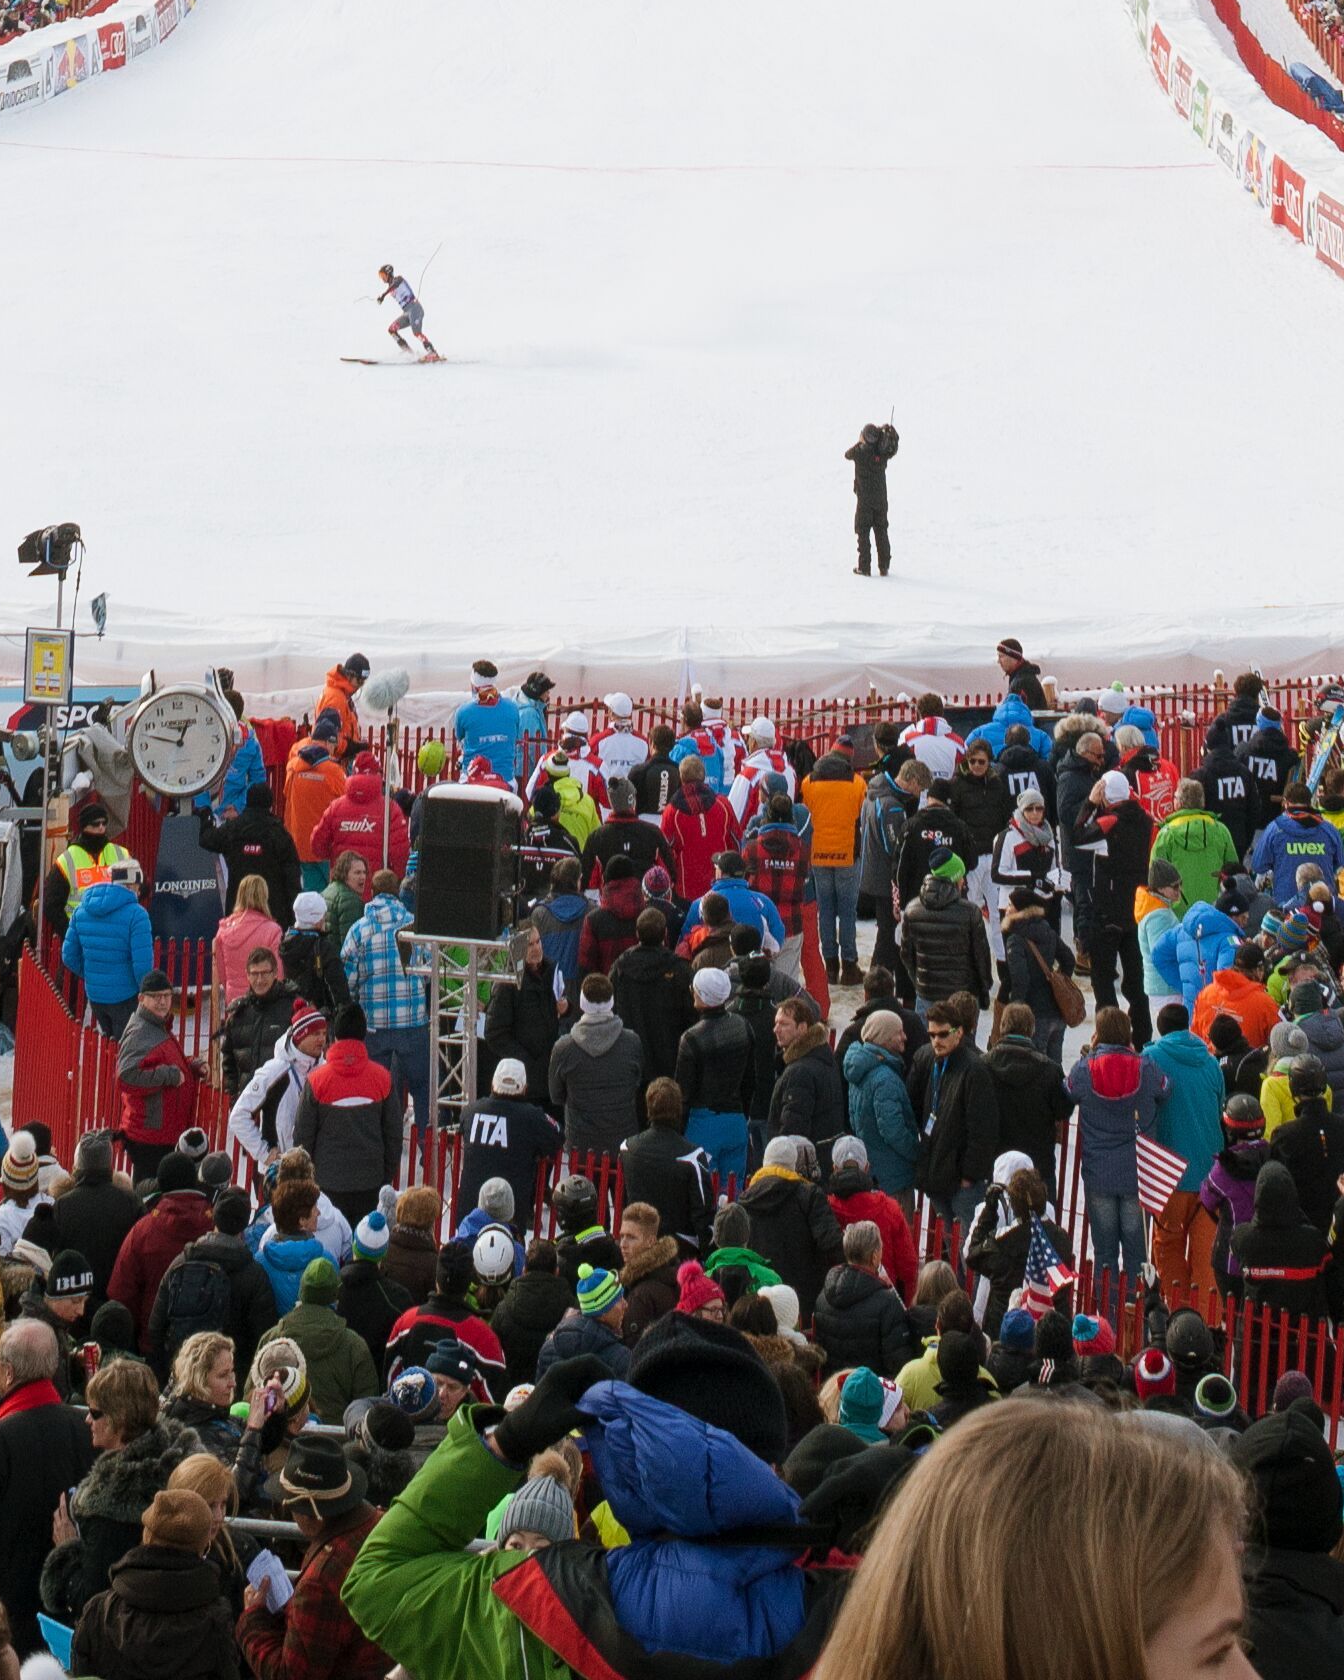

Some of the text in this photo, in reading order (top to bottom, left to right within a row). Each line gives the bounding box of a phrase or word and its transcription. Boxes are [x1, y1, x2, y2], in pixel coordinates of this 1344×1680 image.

[0, 81, 41, 111] BRIDGESTONE
[172, 701, 183, 709] 12
[194, 704, 199, 713] 1
[156, 708, 164, 717] 11
[145, 723, 155, 732] 10
[160, 719, 197, 728] LONGINES
[211, 734, 220, 743] 3
[139, 742, 149, 752] 9
[207, 754, 216, 763] 4
[1249, 756, 1278, 782] ITA
[160, 773, 169, 782] 7
[196, 770, 205, 779] 5
[178, 776, 187, 785] 6
[1008, 772, 1041, 796] ITA
[1217, 776, 1246, 801] ITA
[244, 844, 261, 853] ORF
[1286, 842, 1325, 856] uvex
[764, 859, 795, 867] CANADA
[155, 879, 217, 893] LONGINES
[470, 1113, 508, 1148] ITA
